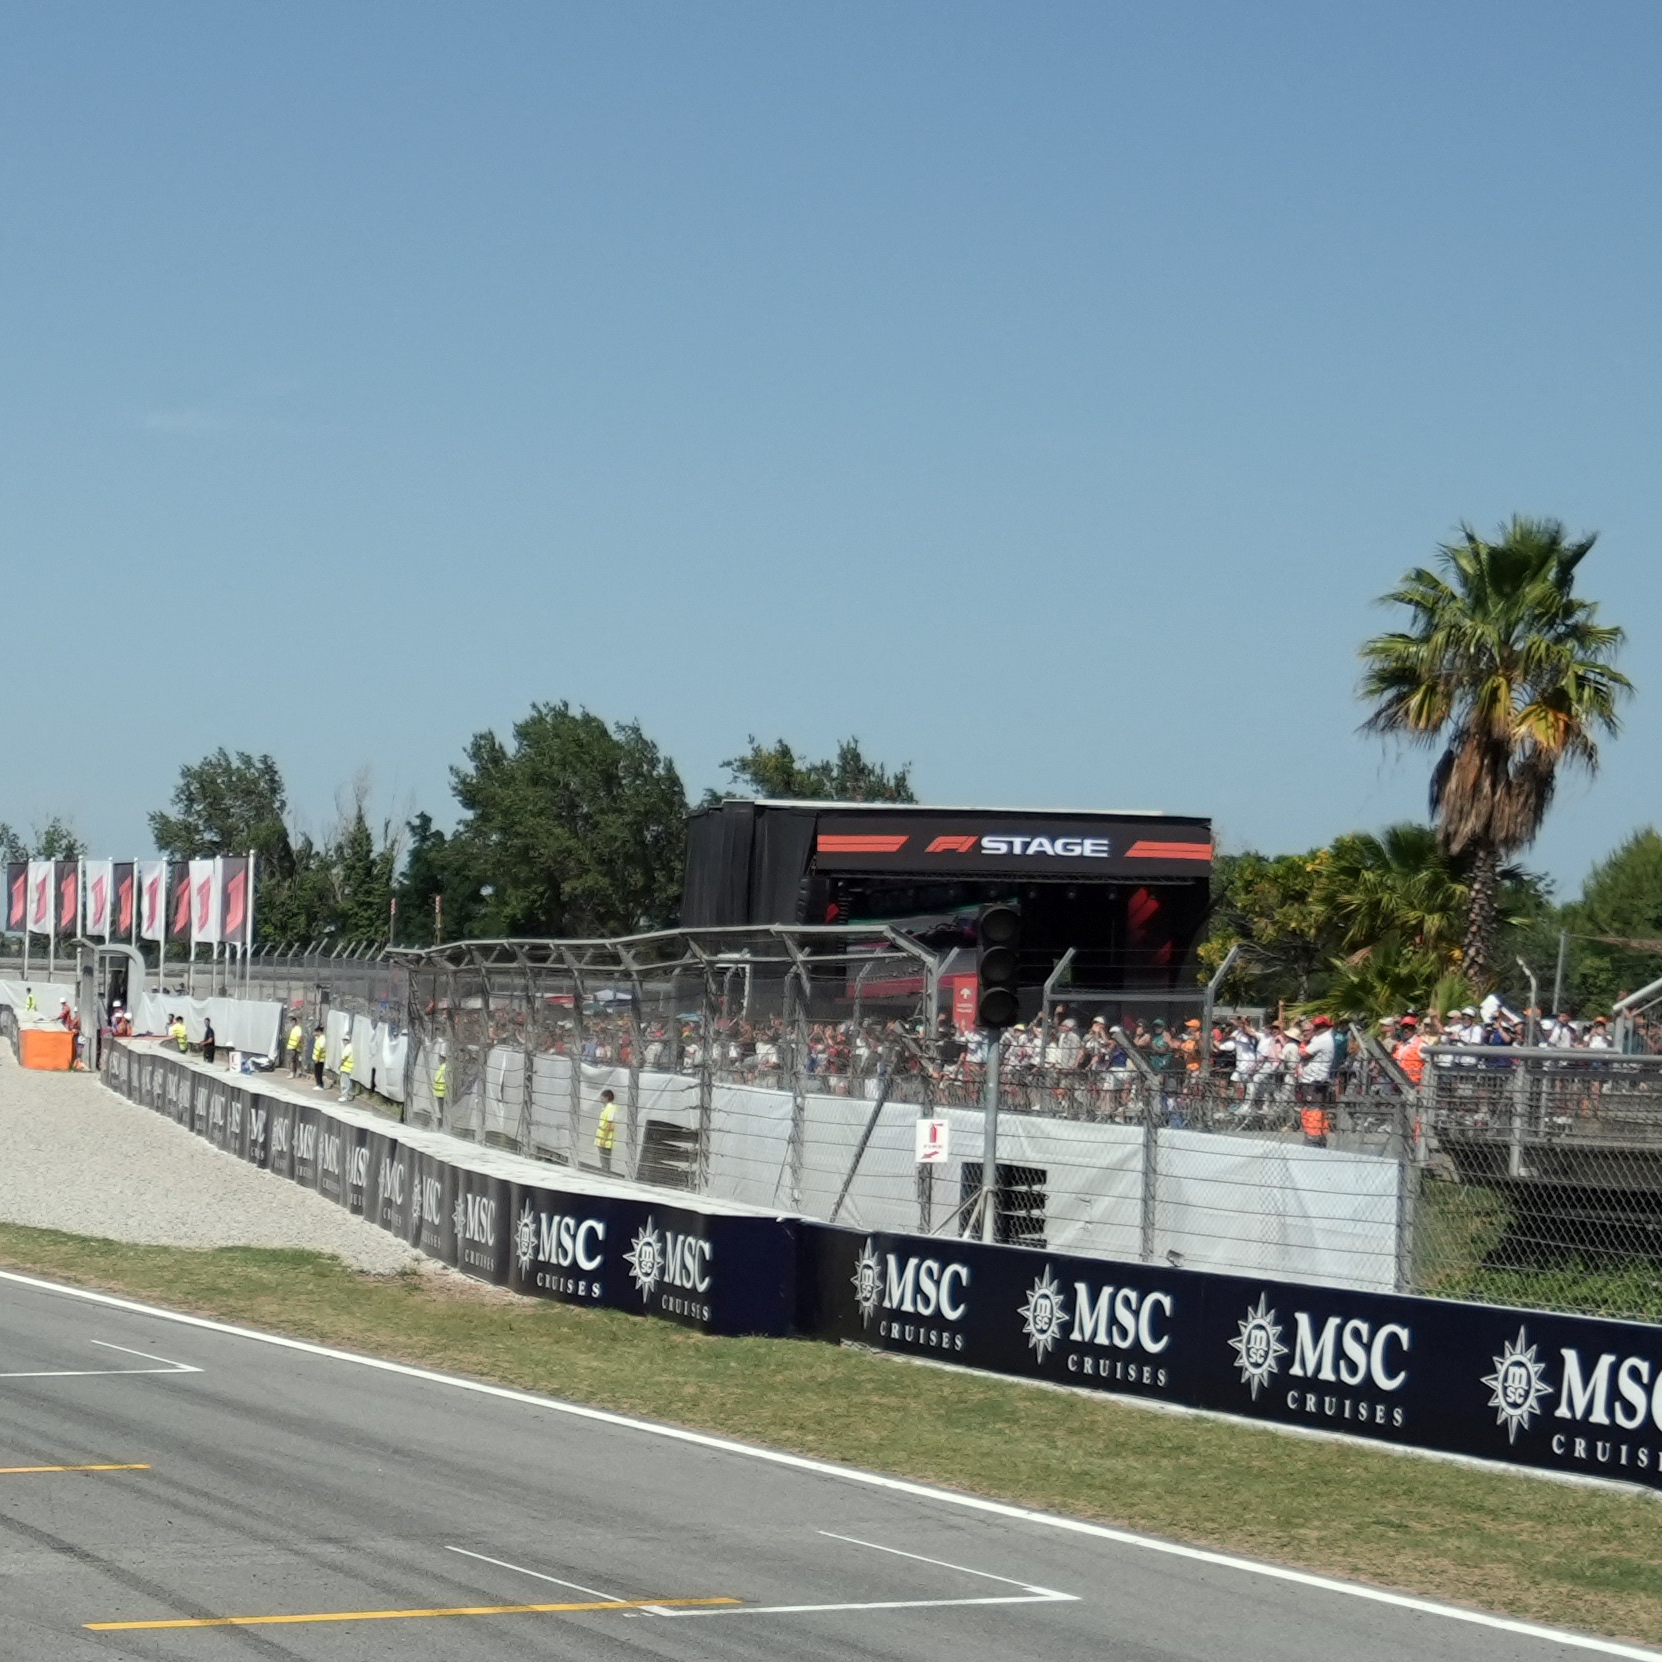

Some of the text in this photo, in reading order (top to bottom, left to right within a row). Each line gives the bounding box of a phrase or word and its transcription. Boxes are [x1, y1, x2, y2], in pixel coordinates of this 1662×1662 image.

[980, 835, 1110, 858] STAGE
[465, 1194, 495, 1248] MSC
[537, 1212, 607, 1271] MSC
[536, 1271, 602, 1298] CRUISES
[662, 1231, 712, 1293] MSC
[661, 1294, 711, 1322] CRUISES
[882, 1254, 969, 1321] MSC
[879, 1320, 964, 1352] CRUISES
[1069, 1282, 1174, 1354] MSC
[1067, 1354, 1168, 1388] CRUISES
[1289, 1311, 1411, 1391] MSC
[1286, 1390, 1405, 1428] CRUISES
